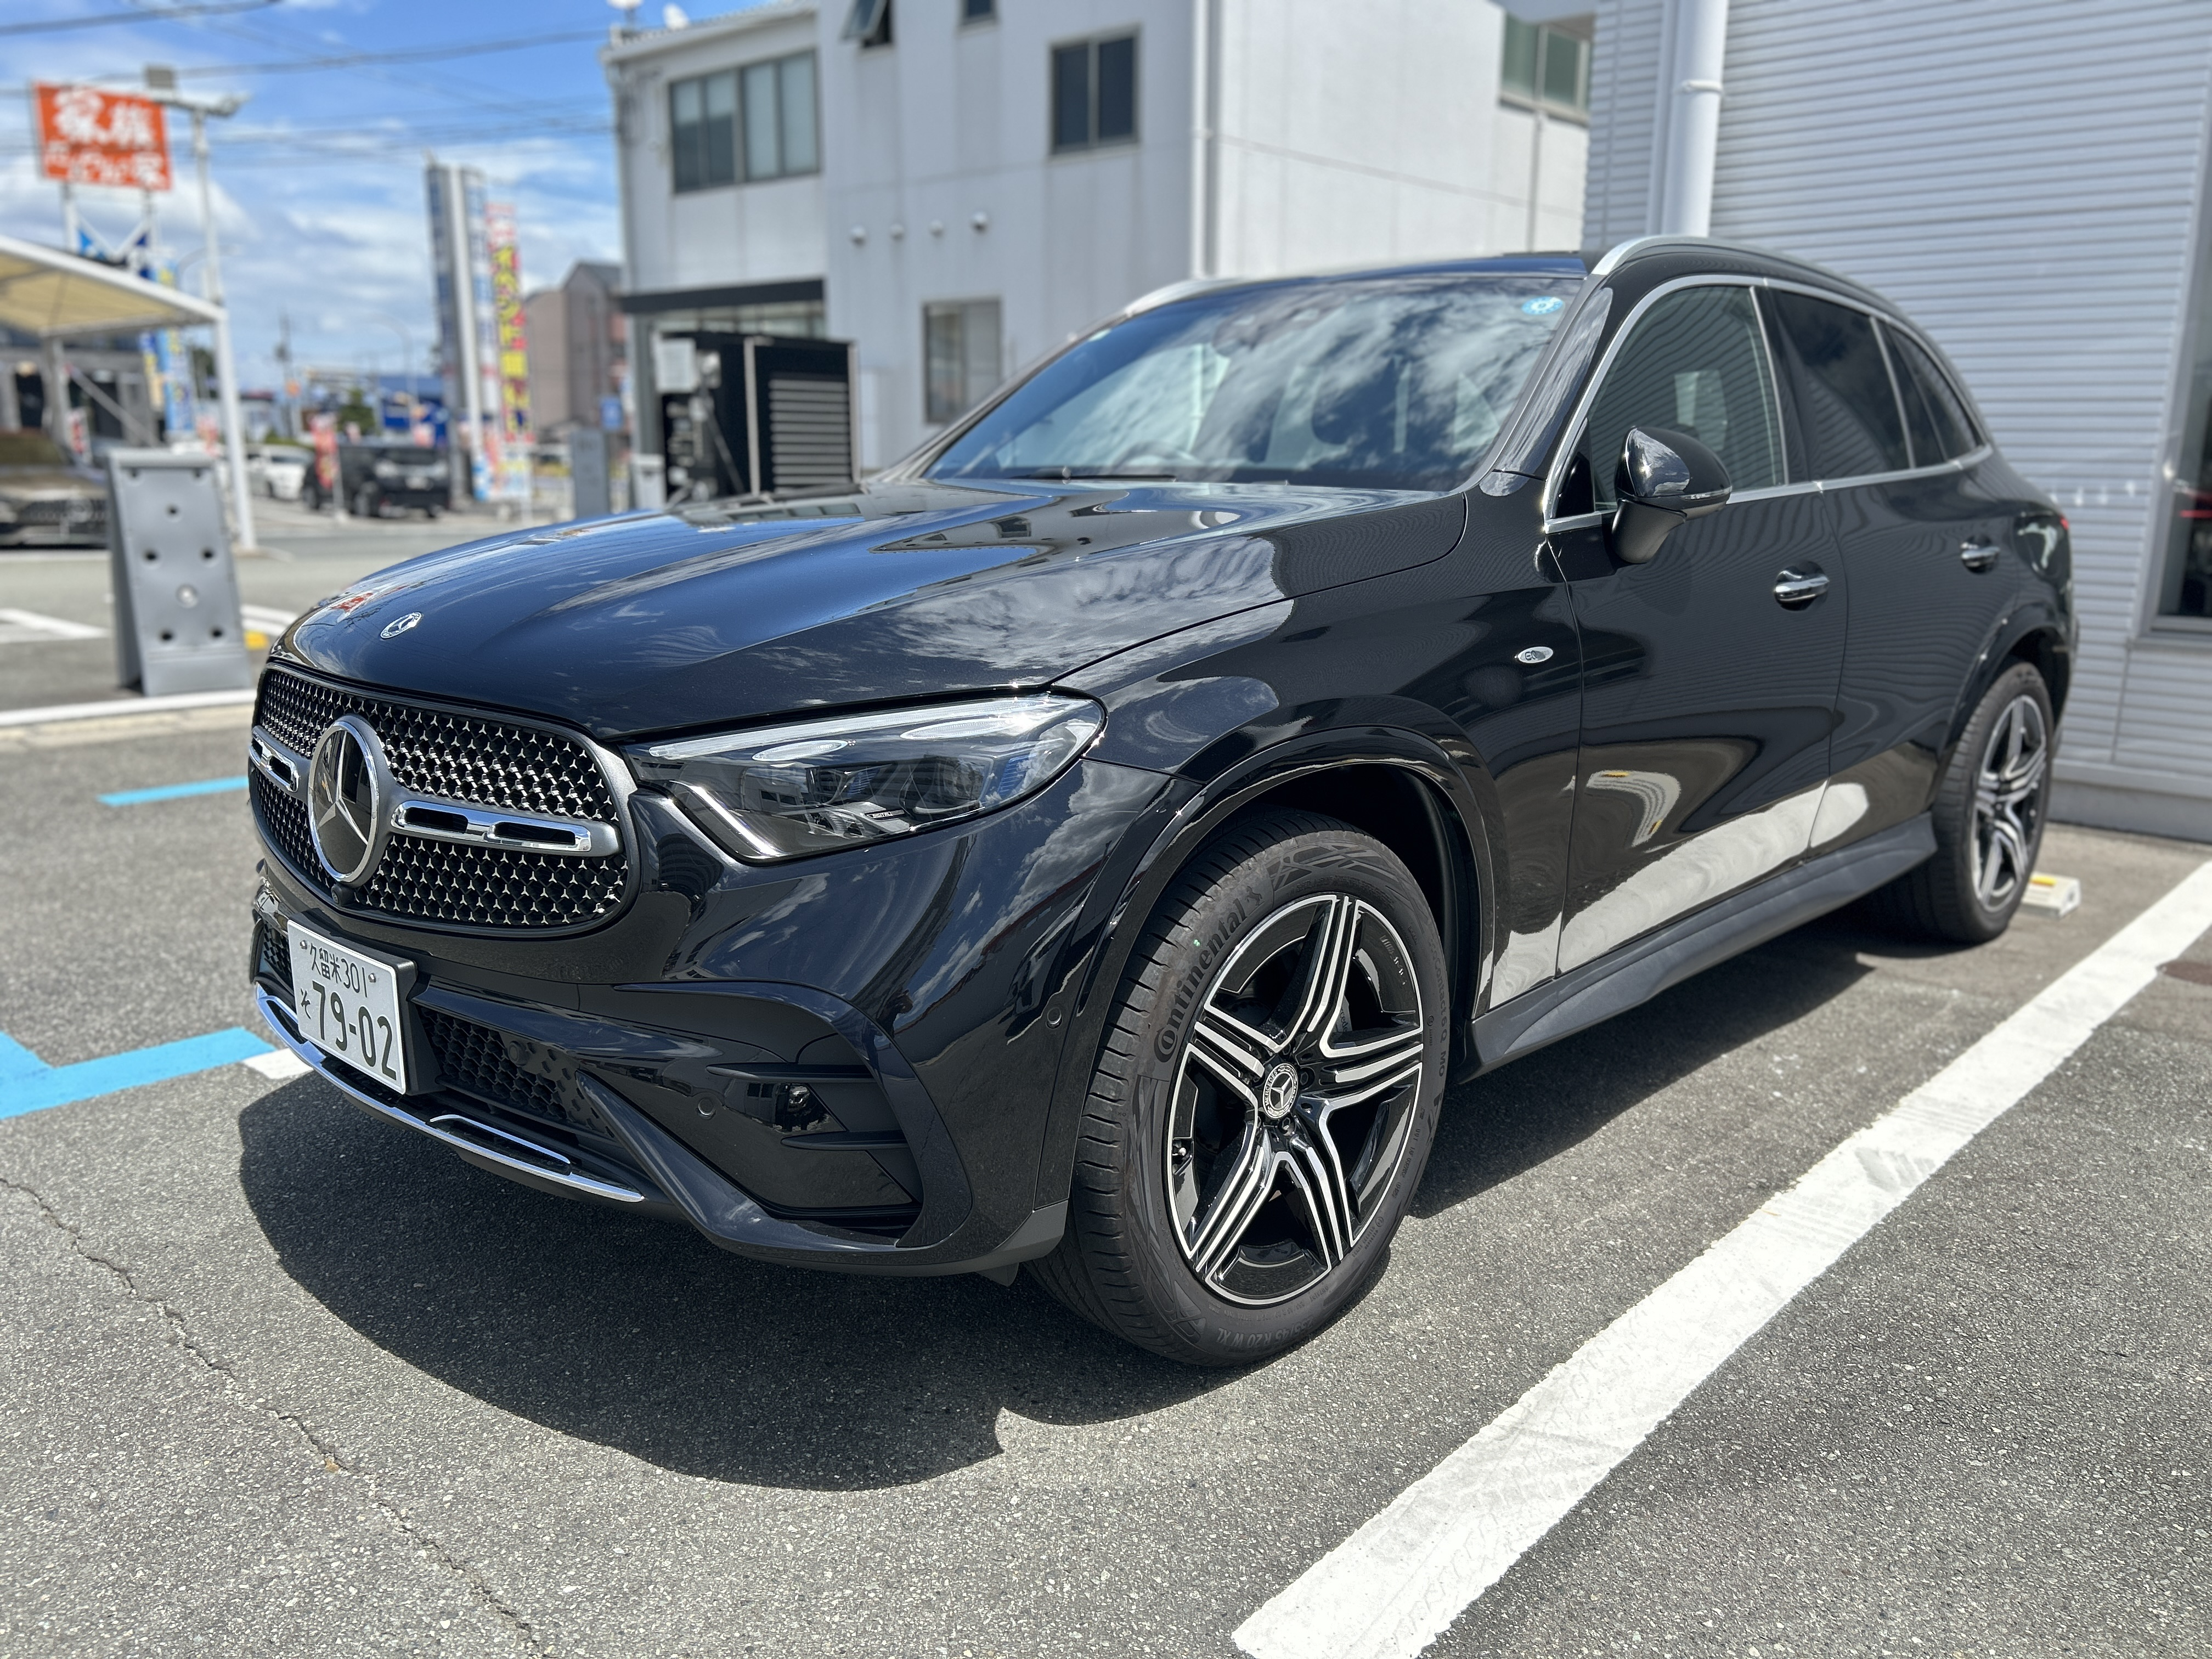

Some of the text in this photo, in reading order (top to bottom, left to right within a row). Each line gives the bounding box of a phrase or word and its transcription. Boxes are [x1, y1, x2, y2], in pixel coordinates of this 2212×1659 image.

[301, 988, 311, 1019] そ
[309, 943, 368, 998] 久留米 301
[1153, 898, 1246, 1063] Continental
[312, 980, 397, 1081] 79-02
